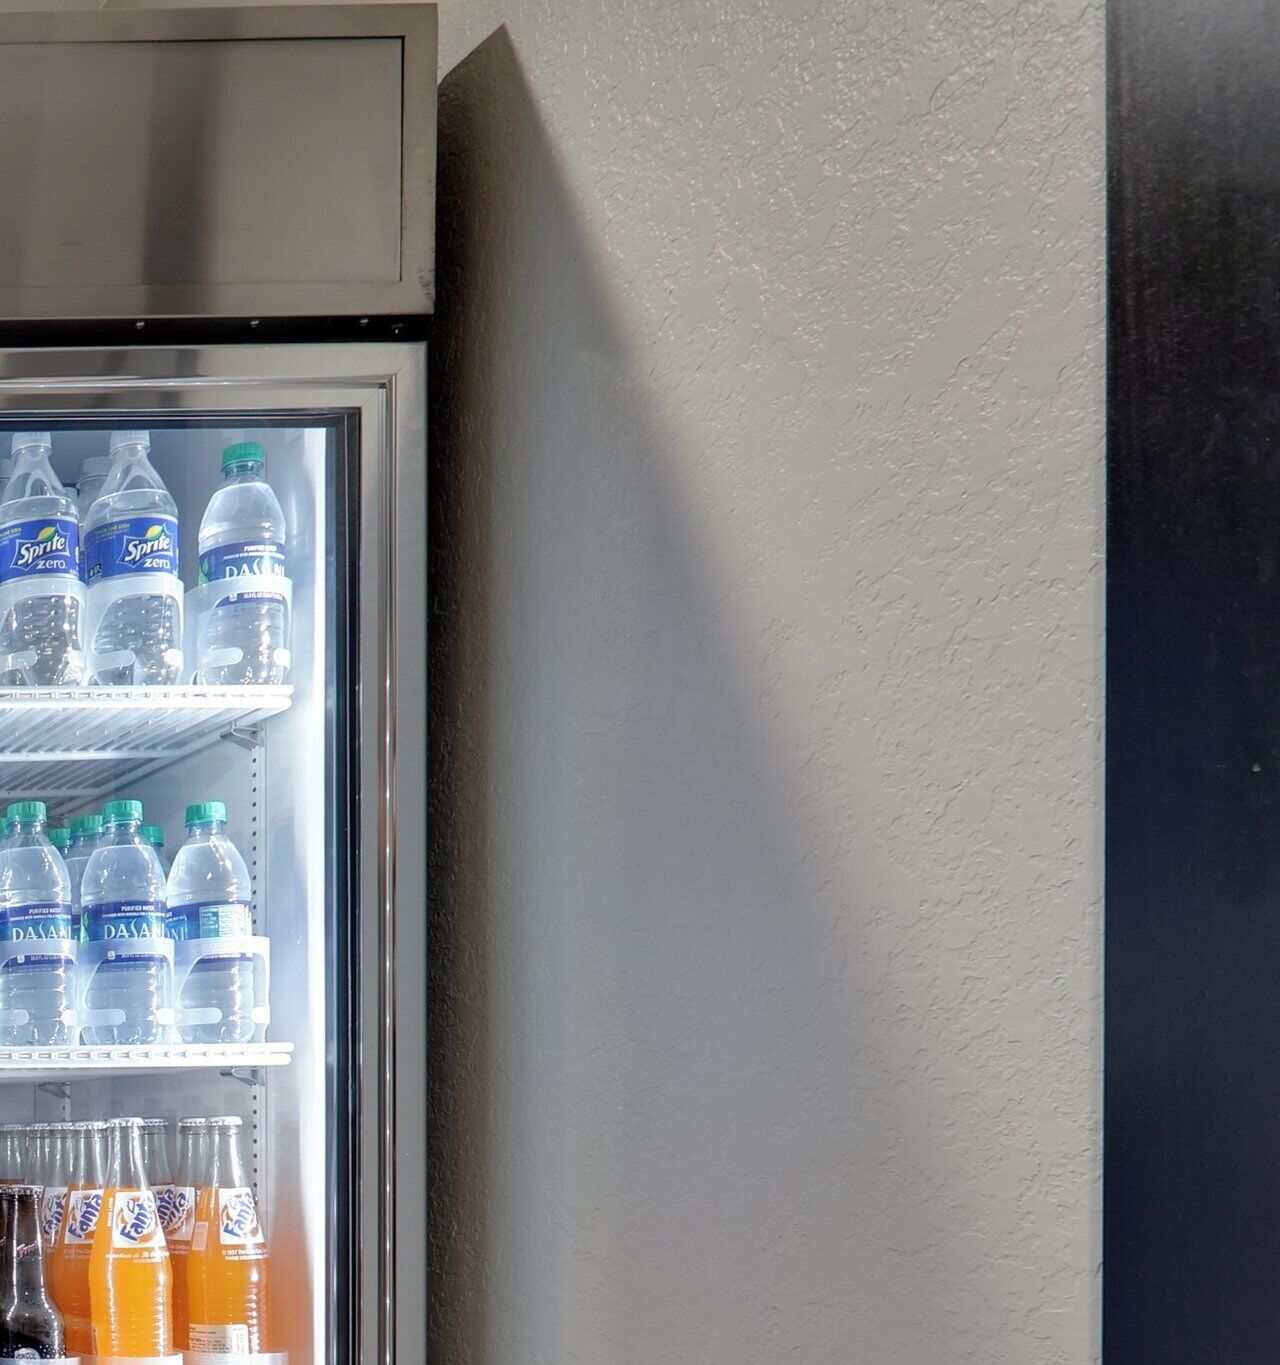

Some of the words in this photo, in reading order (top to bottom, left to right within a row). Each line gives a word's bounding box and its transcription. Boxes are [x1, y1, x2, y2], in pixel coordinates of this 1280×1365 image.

[17, 534, 65, 565] Sprite
[124, 533, 171, 562] Sprite
[36, 559, 66, 570] zero
[143, 557, 171, 569] zero
[12, 920, 71, 943] DASANI
[104, 919, 164, 941] DASANI
[67, 1193, 103, 1240] Fanta
[120, 1194, 158, 1243] Fanta
[223, 1191, 258, 1240] Fanta
